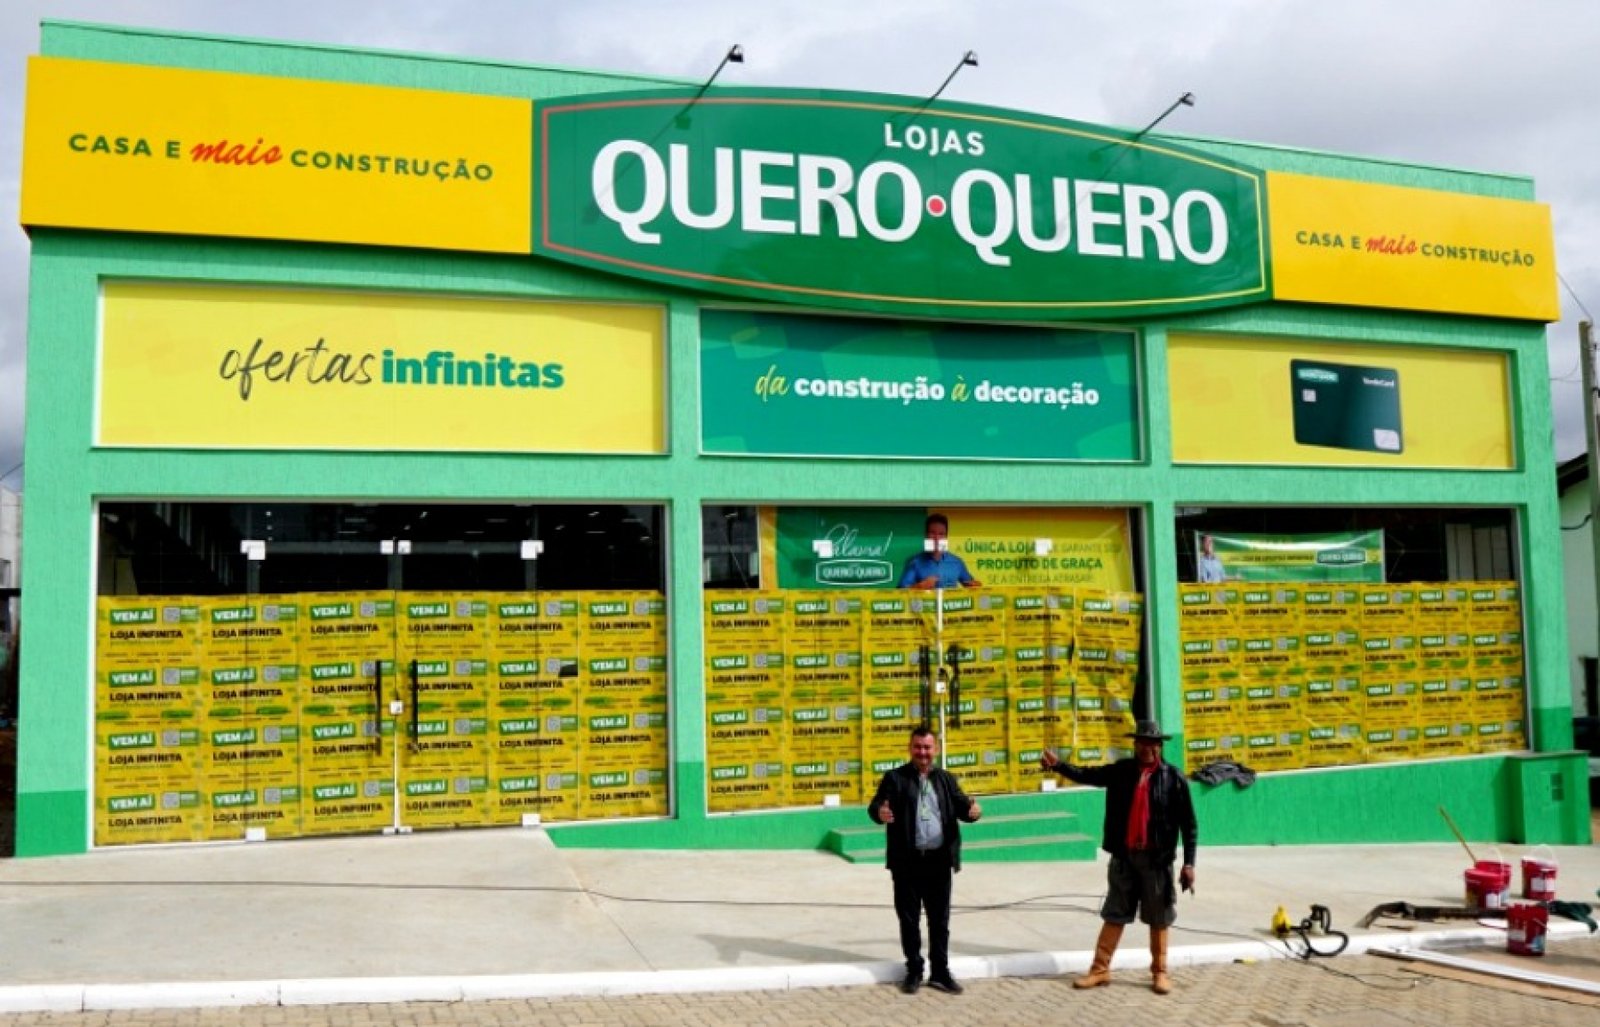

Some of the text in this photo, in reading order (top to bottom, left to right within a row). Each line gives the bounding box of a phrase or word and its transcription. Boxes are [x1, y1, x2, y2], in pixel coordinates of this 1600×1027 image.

[884, 123, 985, 156] LOJAS
[68, 133, 493, 182] CASA E mais CONSTRUÇÃO
[592, 139, 1229, 267] QUERO QUERO
[1296, 230, 1535, 267] CASA E mais CONSTRUÇÃO
[219, 338, 565, 401] ofertas infinitas
[755, 365, 1099, 410] da construção à decoração
[964, 538, 1006, 554] ÚNICA
[977, 557, 1103, 572] PRODUTO DE GRAÇA
[214, 610, 239, 620] VEM
[313, 608, 337, 617] VEM
[411, 606, 435, 617] VEM
[502, 606, 524, 617] VEM
[592, 604, 615, 615] VEM
[113, 611, 139, 621] VEM
[313, 666, 337, 677] VEM
[502, 663, 524, 674] VEM
[592, 661, 614, 672] VEM
[112, 673, 138, 684] VEM
[214, 671, 239, 681] VEM
[502, 721, 525, 732] VEM
[592, 718, 614, 728] VEM
[215, 732, 240, 743] VEM
[315, 727, 339, 738] VEM
[111, 736, 137, 747] VEM
[502, 780, 525, 790] VEM
[592, 776, 614, 786] VEM
[316, 787, 340, 798] VEM
[408, 783, 432, 794] VEM
[111, 798, 137, 809] VEM
[216, 794, 241, 805] VEM
